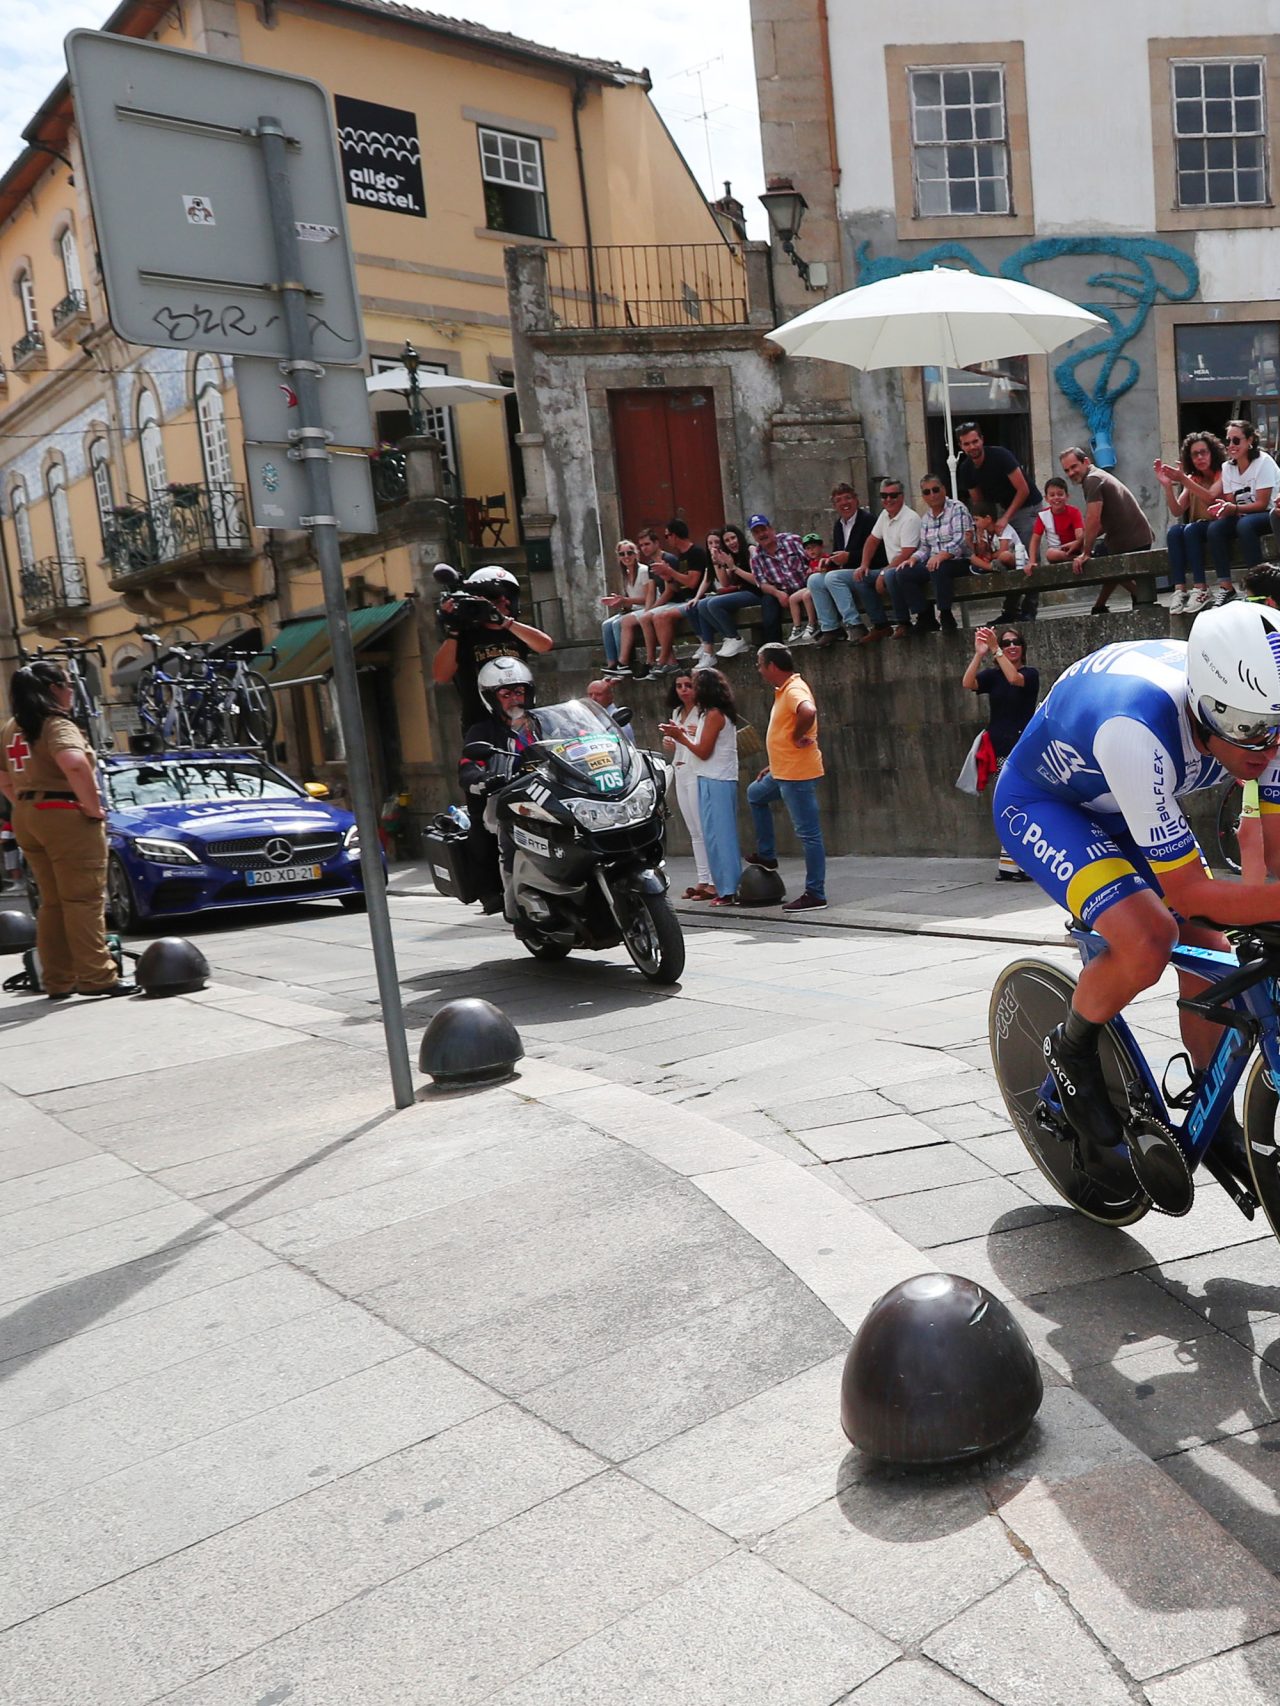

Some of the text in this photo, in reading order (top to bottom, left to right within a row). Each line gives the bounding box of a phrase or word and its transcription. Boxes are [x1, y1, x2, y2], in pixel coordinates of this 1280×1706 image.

[349, 167, 399, 190] allgo
[351, 182, 420, 210] hostel.
[589, 757, 612, 769] META
[594, 771, 624, 792] 705
[528, 837, 548, 851] RTP
[1001, 805, 1074, 882] FC Porto
[1050, 1058, 1077, 1097] PACTO
